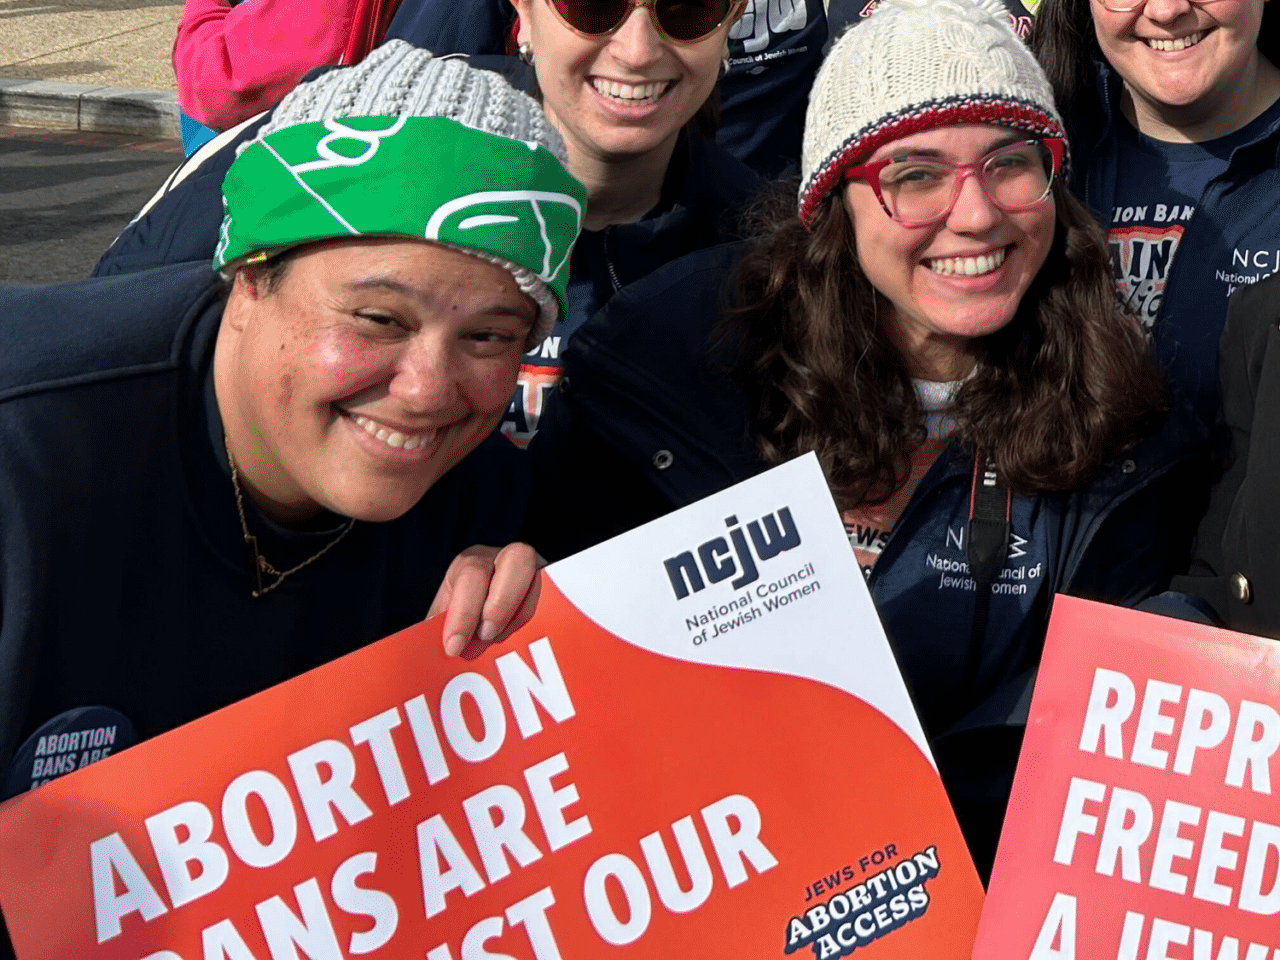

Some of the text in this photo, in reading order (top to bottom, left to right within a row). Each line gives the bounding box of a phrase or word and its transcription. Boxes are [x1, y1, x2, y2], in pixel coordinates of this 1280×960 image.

[1215, 269, 1260, 285] National
[663, 506, 802, 601] ncjw
[1028, 562, 1042, 579] of
[685, 562, 815, 631] National Council
[692, 580, 821, 646] of Jewish Women
[992, 583, 1027, 595] omen
[31, 752, 77, 779] BANS
[34, 725, 117, 758] ABORTION
[90, 636, 576, 944] ABORTION
[417, 753, 593, 919] ARE
[583, 794, 779, 947] OUR
[789, 846, 939, 946] ABORTION
[804, 843, 898, 901] JEWS FOR
[816, 884, 929, 960] ACCESS
